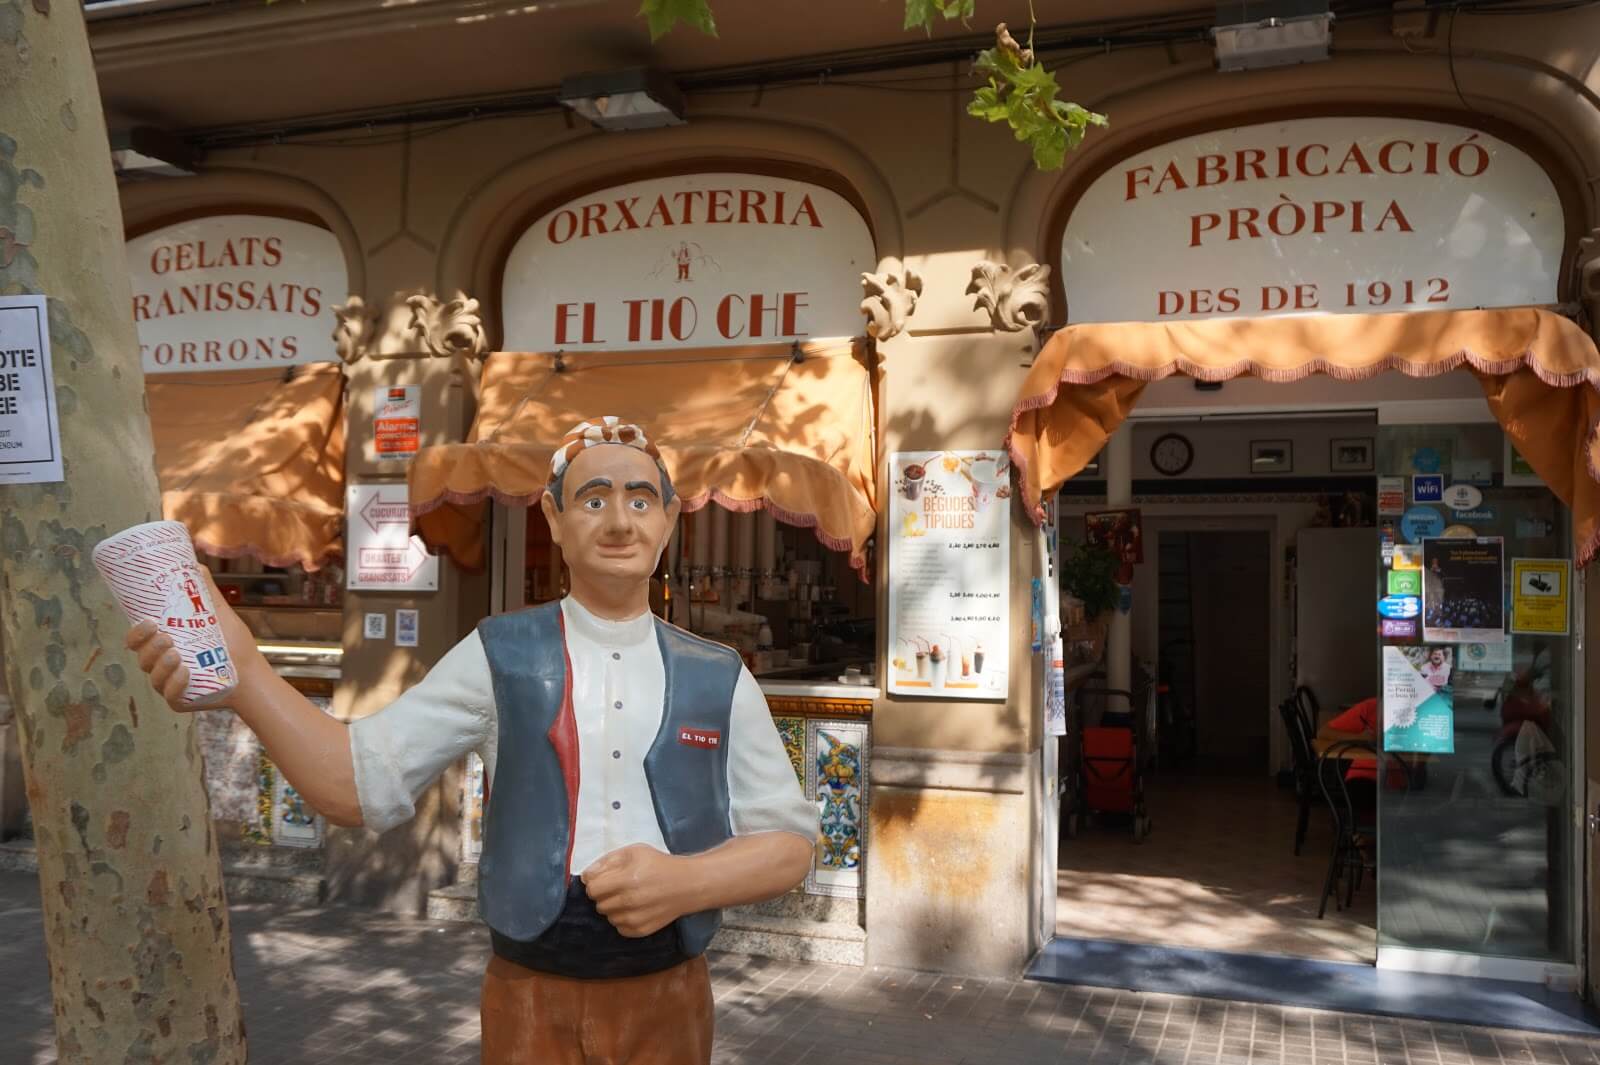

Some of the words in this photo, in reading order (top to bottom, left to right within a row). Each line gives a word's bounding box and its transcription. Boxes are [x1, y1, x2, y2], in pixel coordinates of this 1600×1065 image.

[1124, 134, 1490, 201] FABRICACIÓ
[547, 189, 824, 244] ORXATERIA
[1189, 193, 1415, 247] PRÒPIA
[150, 237, 282, 275] GELATS
[132, 280, 322, 321] RANISSATS
[1157, 287, 1241, 315] DES
[1261, 284, 1319, 311] DE
[1345, 278, 1450, 307] 1912
[555, 302, 606, 344] EL
[622, 296, 697, 341] TIO
[717, 292, 808, 339] CHE
[1455, 510, 1493, 519] facebook
[167, 617, 184, 628] EL
[186, 618, 206, 629] TIO
[694, 735, 706, 743] TIO
